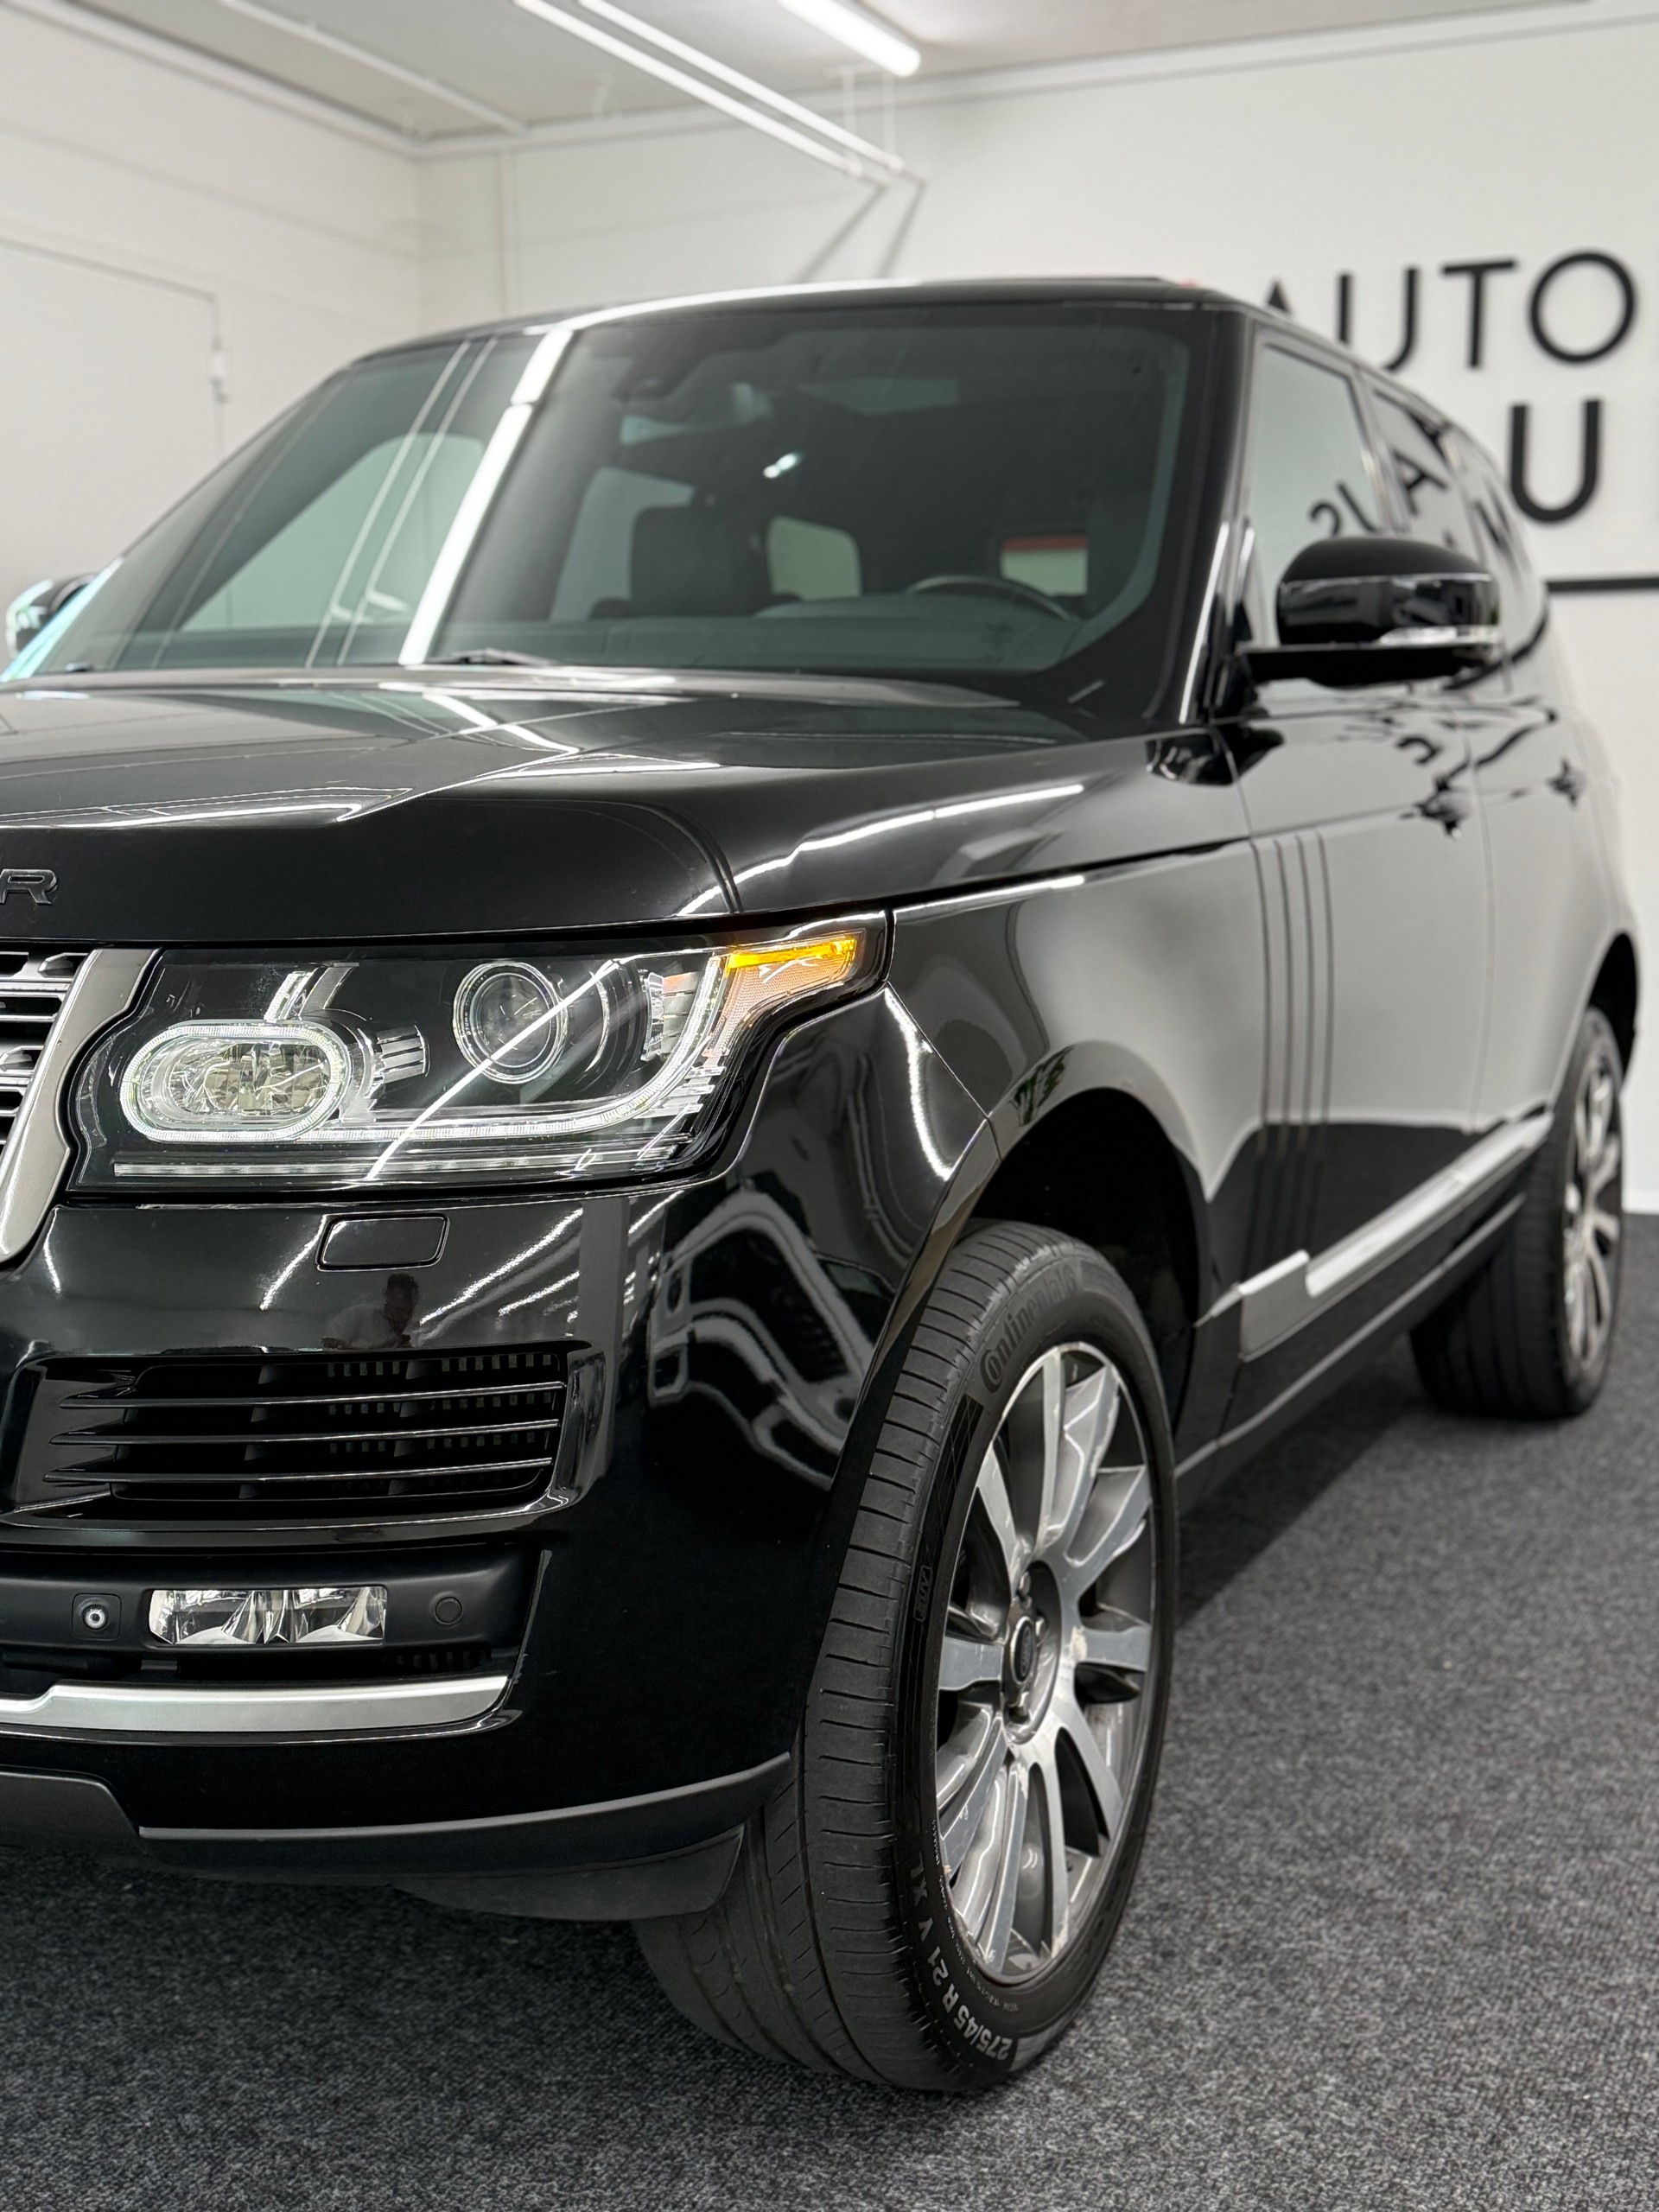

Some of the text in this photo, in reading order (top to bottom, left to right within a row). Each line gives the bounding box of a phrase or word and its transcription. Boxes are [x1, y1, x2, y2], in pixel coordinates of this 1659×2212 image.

[0, 868, 57, 905] R
[980, 1262, 1077, 1394] Continental
[927, 1946, 949, 1986] 21
[942, 1984, 959, 2013] R
[954, 2005, 1013, 2061] 275/45
